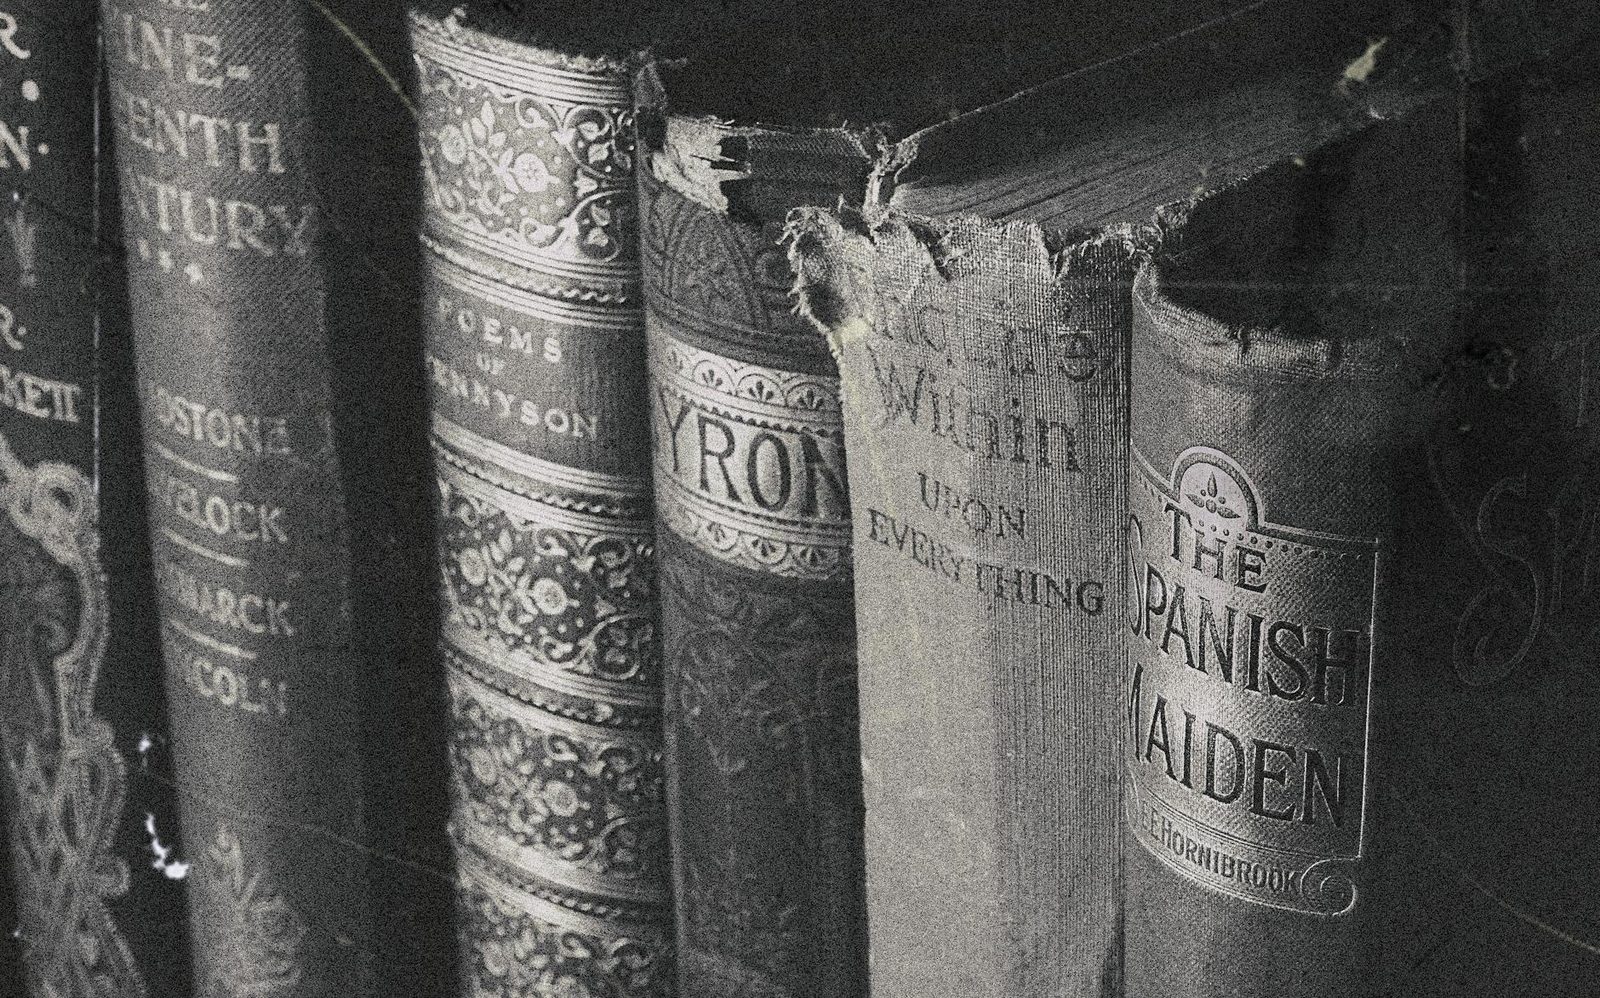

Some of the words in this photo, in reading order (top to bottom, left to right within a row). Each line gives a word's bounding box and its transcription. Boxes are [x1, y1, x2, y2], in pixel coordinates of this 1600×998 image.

[437, 296, 562, 363] POEMS
[476, 351, 507, 376] OF
[866, 344, 1081, 472] Within
[918, 472, 1026, 540] UPON
[1164, 503, 1268, 593] THE
[1128, 514, 1356, 704] SPANISH
